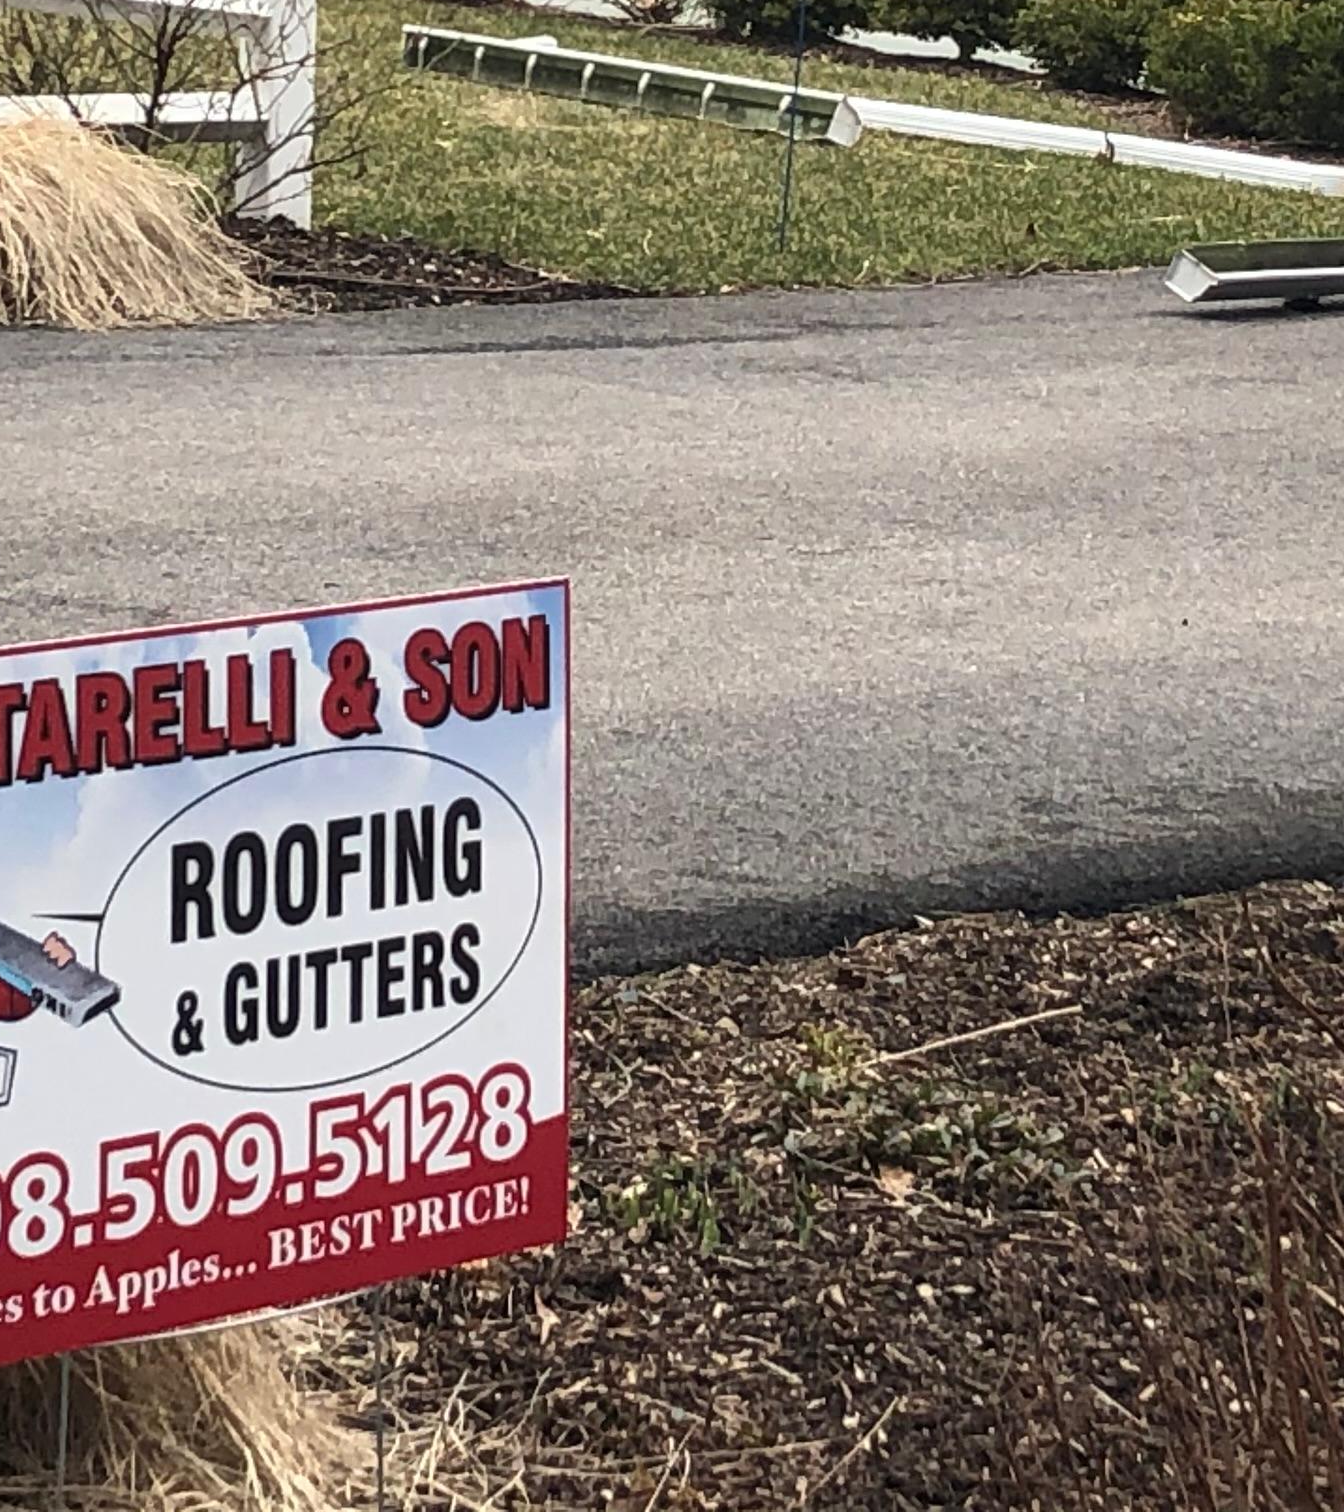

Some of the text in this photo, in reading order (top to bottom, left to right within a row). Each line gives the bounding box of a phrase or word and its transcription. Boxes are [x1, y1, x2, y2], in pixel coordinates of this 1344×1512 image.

[322, 638, 382, 739] &
[404, 615, 550, 728] SON
[170, 796, 483, 944] ROOFING
[171, 922, 482, 1056] & GUTTERS
[31, 1283, 76, 1317] to
[83, 1248, 258, 1315] Apples...
[267, 1209, 384, 1270] BEST
[390, 1175, 531, 1243] PRICE!
